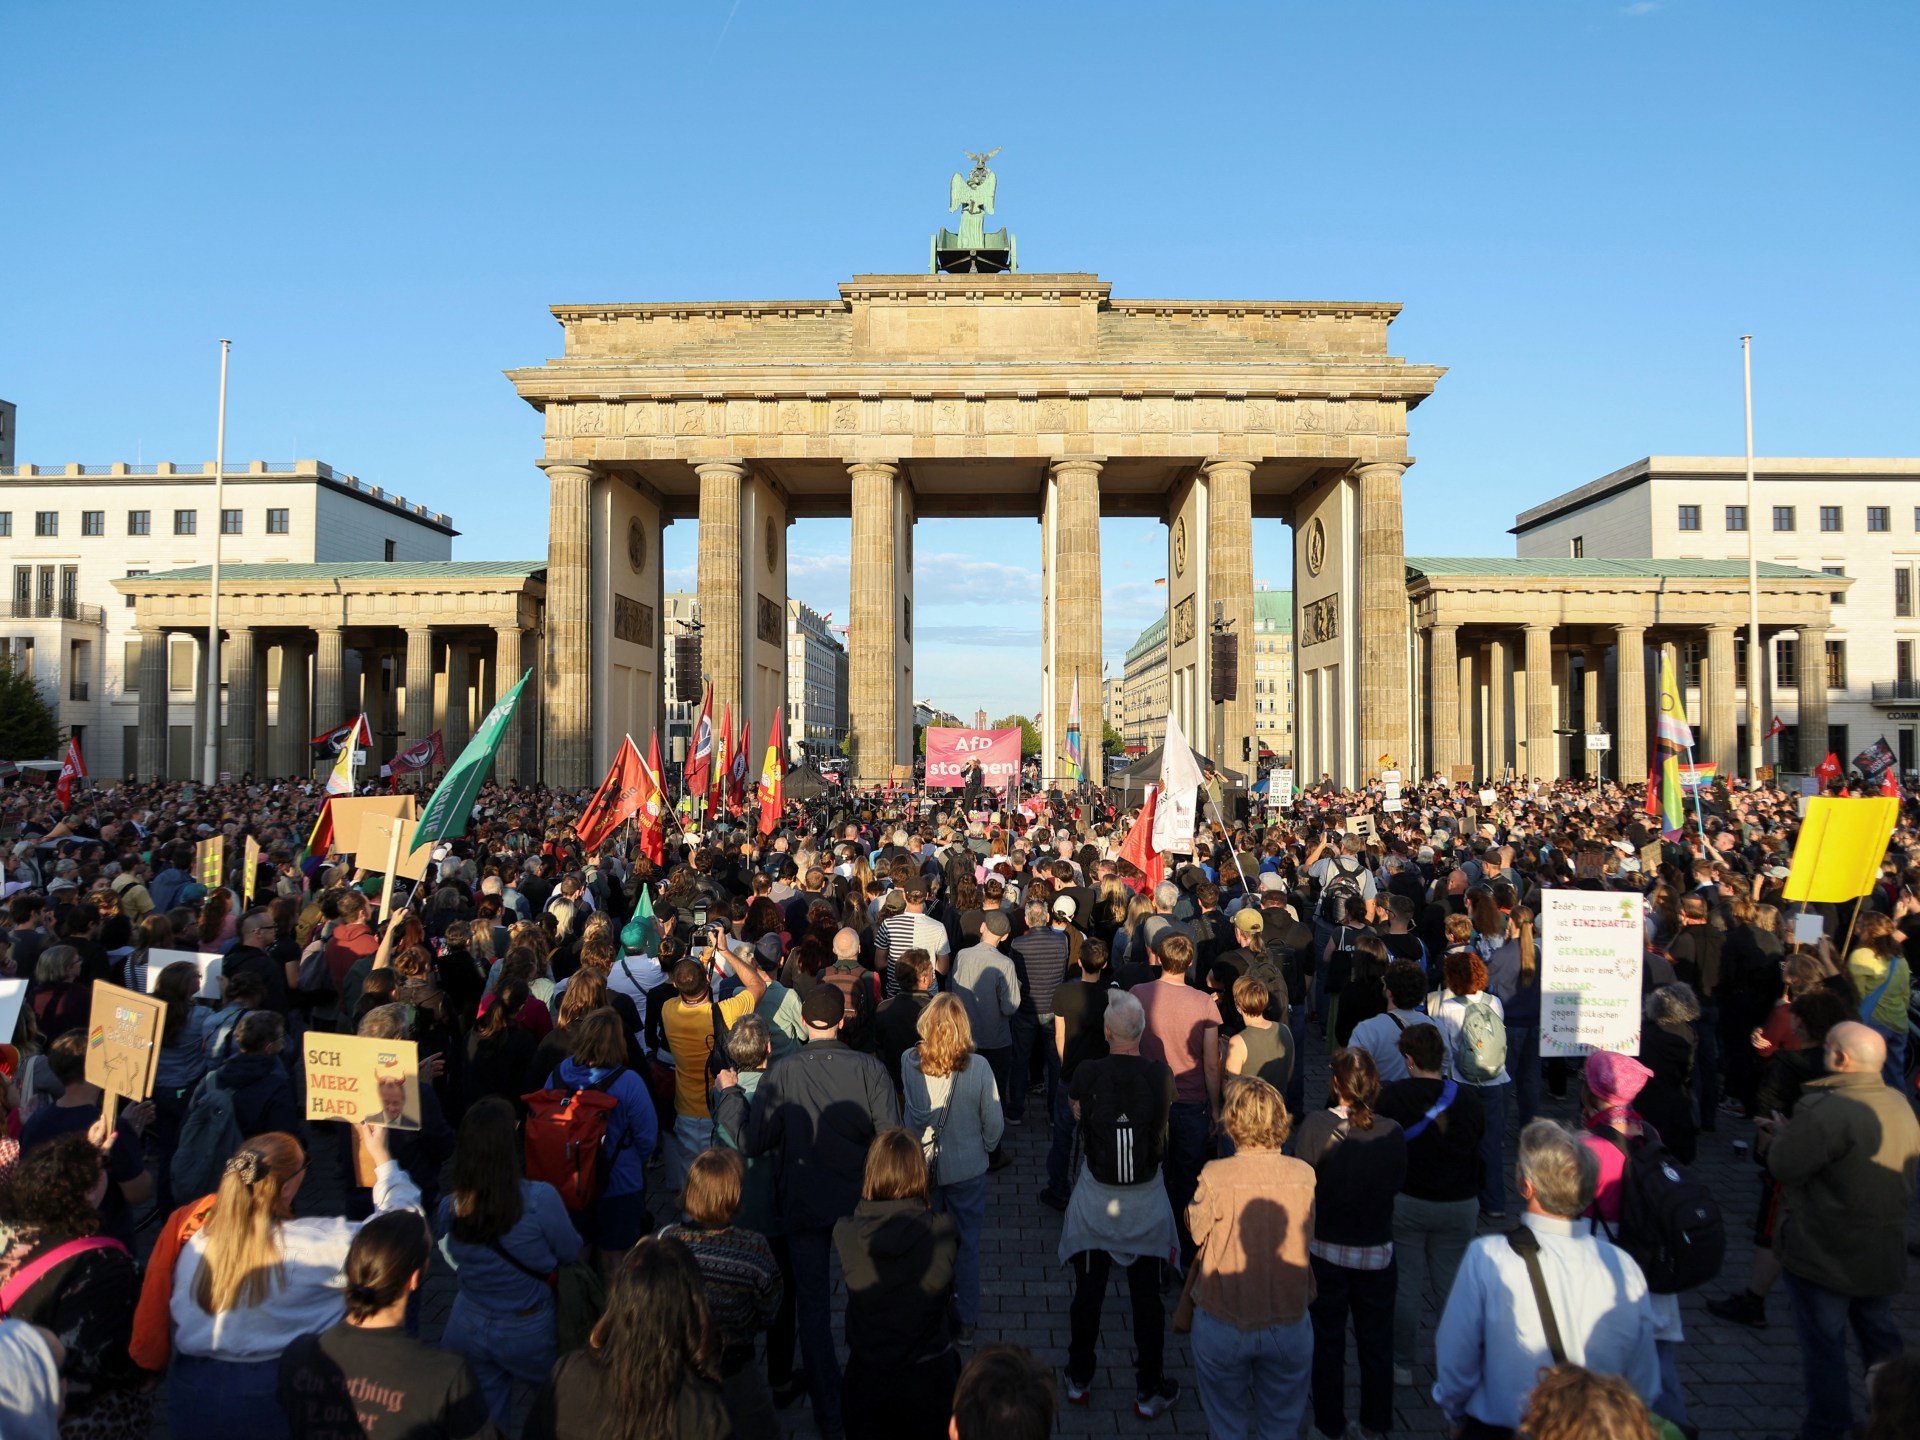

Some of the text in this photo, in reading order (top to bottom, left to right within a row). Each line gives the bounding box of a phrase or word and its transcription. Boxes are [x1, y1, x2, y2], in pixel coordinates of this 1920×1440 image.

[954, 736, 993, 751] AfD
[929, 759, 1019, 775] stoen!
[639, 813, 652, 828] SIND
[1599, 904, 1613, 912] uns
[1572, 919, 1637, 928] EINZIGARTIG
[1554, 933, 1572, 942] aber
[1557, 947, 1616, 957] GEMEINSAM
[1553, 964, 1580, 974] bilden
[1597, 967, 1614, 975] eine
[1553, 996, 1630, 1007] GEMEINSCHAFT
[115, 1007, 145, 1024] BUNT
[1551, 1009, 1576, 1021] gegen
[308, 1049, 341, 1067] SCH
[378, 1054, 396, 1063] CDU
[310, 1073, 359, 1093] MERZ
[311, 1097, 358, 1116] HAFD
